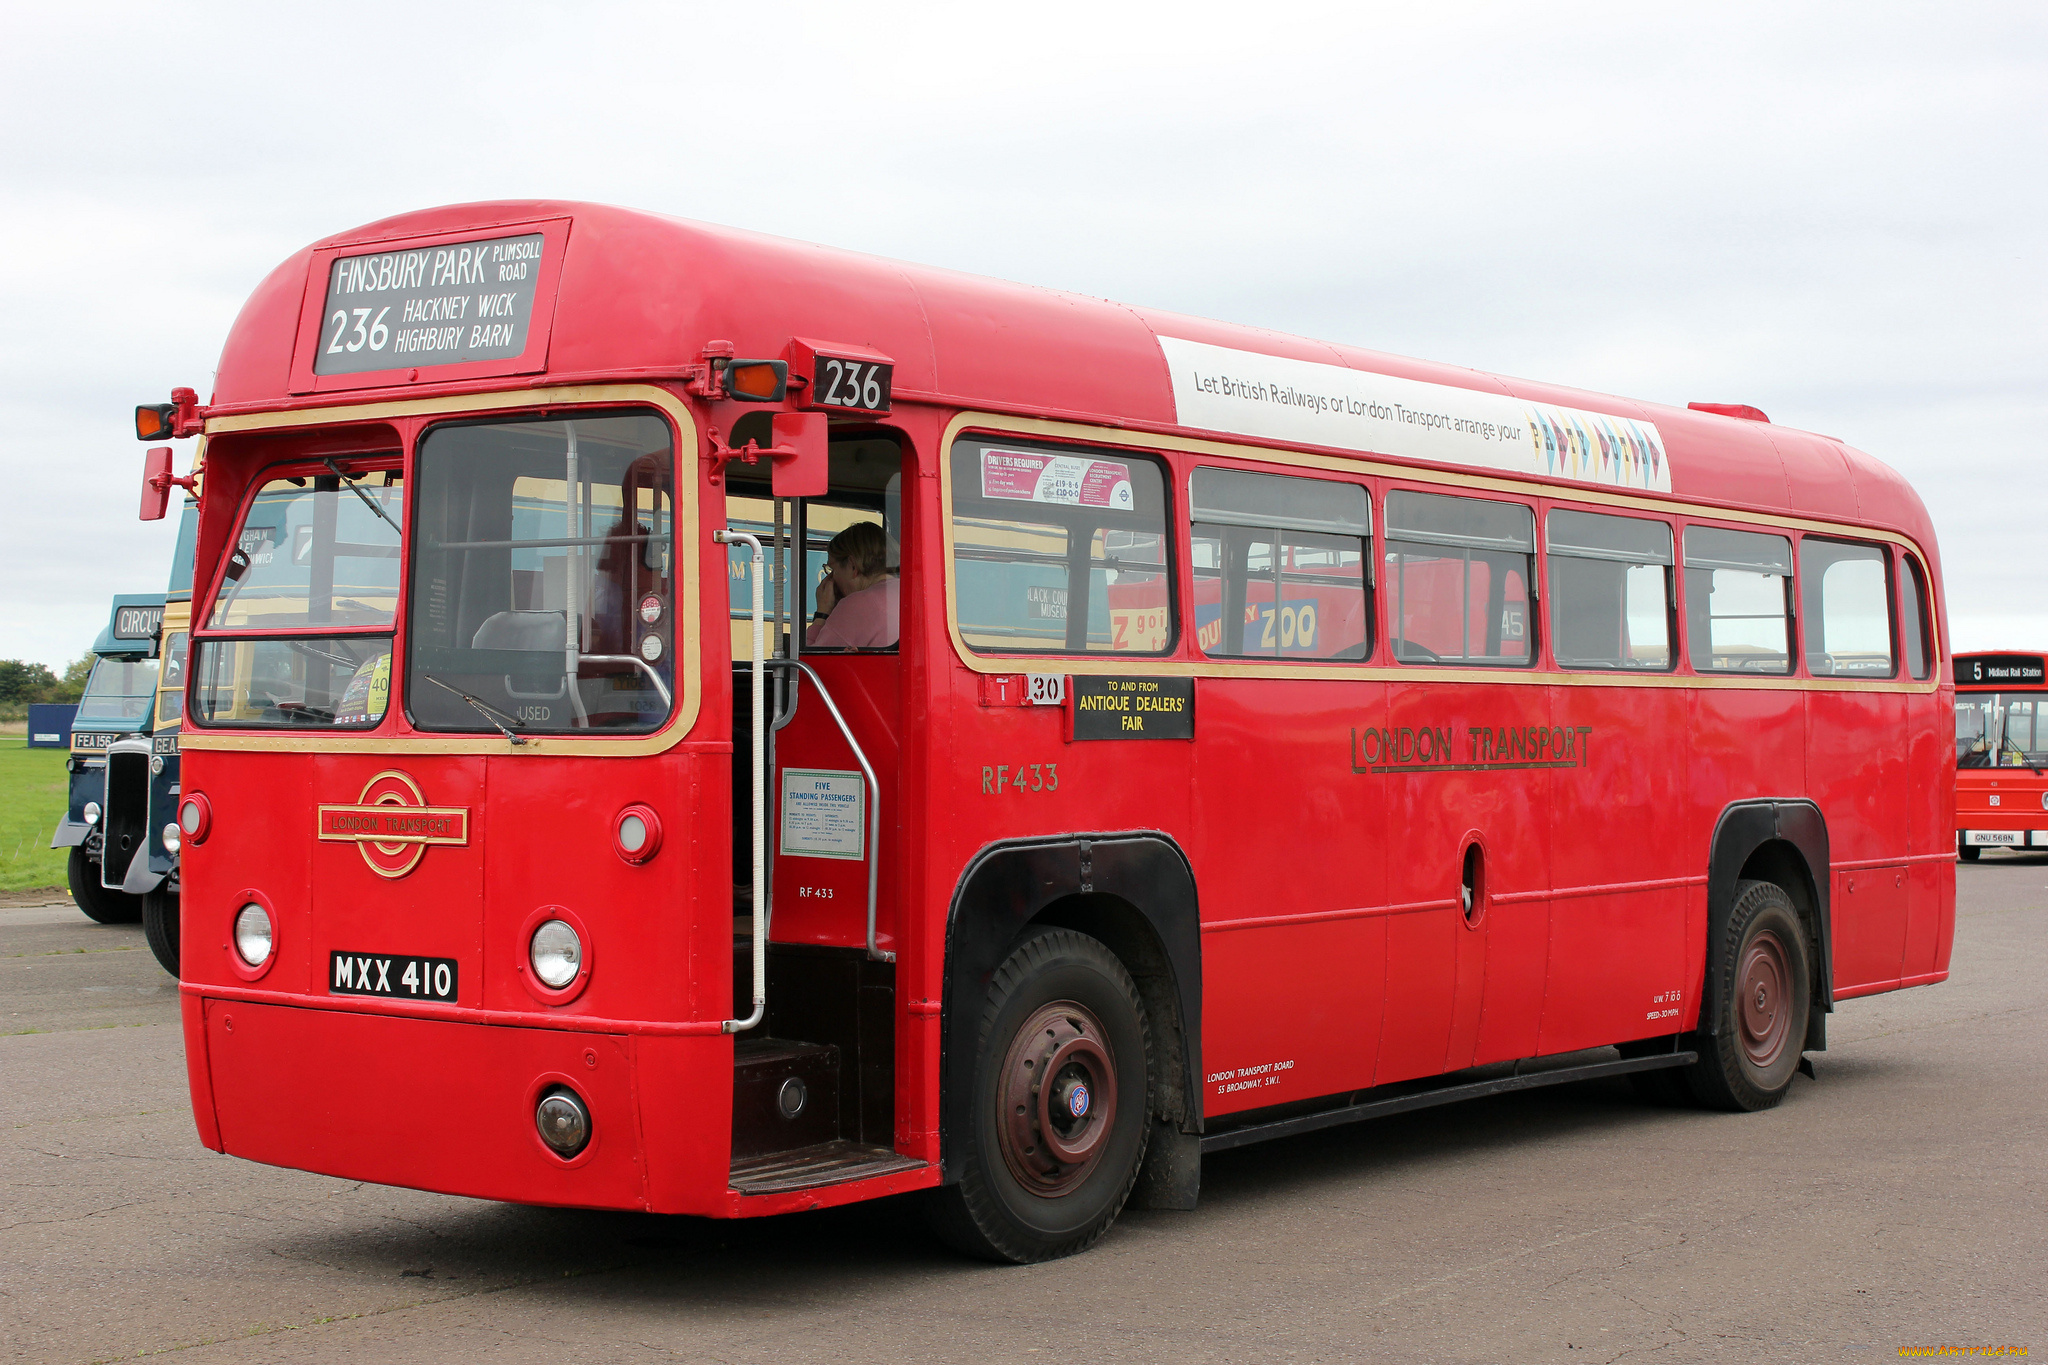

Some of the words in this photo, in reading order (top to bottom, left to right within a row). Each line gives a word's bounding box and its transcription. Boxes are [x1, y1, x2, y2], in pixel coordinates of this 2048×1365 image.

[492, 242, 540, 262] PLIMSOLL
[336, 252, 430, 294] FINSBURY
[432, 246, 488, 286] PARK
[500, 263, 526, 282] ROAD
[403, 296, 470, 322] HACKNEY
[478, 293, 517, 318] WICK
[327, 307, 391, 354] 236
[395, 327, 464, 353] HIGHBURY
[470, 324, 514, 348] BARN
[824, 360, 880, 409] 236
[1194, 372, 1219, 394] Let
[1222, 376, 1268, 401] British
[1270, 384, 1327, 414] Railways
[1331, 398, 1343, 412] or
[1346, 396, 1393, 420] London
[1394, 404, 1451, 431] Transport
[1455, 418, 1495, 440] arrange
[1498, 424, 1520, 441] your
[1530, 422, 1586, 456] PARTY
[1599, 433, 1658, 466] OUTING
[988, 455, 1013, 466] DRIVERS
[1014, 458, 1043, 469] REQUIRED
[1137, 610, 1166, 634] goi
[1261, 605, 1316, 648] ZOO
[1502, 610, 1523, 636] 45
[1974, 662, 1982, 680] 5
[1988, 668, 2009, 677] Midland
[2010, 668, 2020, 677] Rail
[2022, 668, 2042, 677] Station
[372, 678, 388, 692] 40
[1034, 677, 1058, 700] 30
[1108, 682, 1118, 690] TO
[1121, 682, 1136, 691] AND
[1139, 682, 1158, 692] FROM
[520, 706, 550, 720] USED
[1079, 695, 1130, 711] ANTIQUE
[1136, 697, 1185, 712] DEALERS'
[1122, 716, 1143, 730] FAIR
[77, 734, 94, 747] FEA
[96, 735, 111, 748] 156
[156, 738, 175, 752] GEA
[1352, 727, 1451, 774] LONDON
[1469, 726, 1592, 767] TRANSPORT
[815, 782, 830, 790] FIVE
[790, 792, 818, 800] STANDING
[821, 794, 856, 802] PASSENGERS
[332, 817, 378, 830] LONDON
[386, 818, 451, 832] TRANSPORT
[336, 956, 392, 992] MXX
[402, 962, 451, 996] 410
[1207, 1070, 1235, 1083] LONDON
[1237, 1064, 1272, 1077] TRANSPORT
[1274, 1060, 1294, 1071] BOARD
